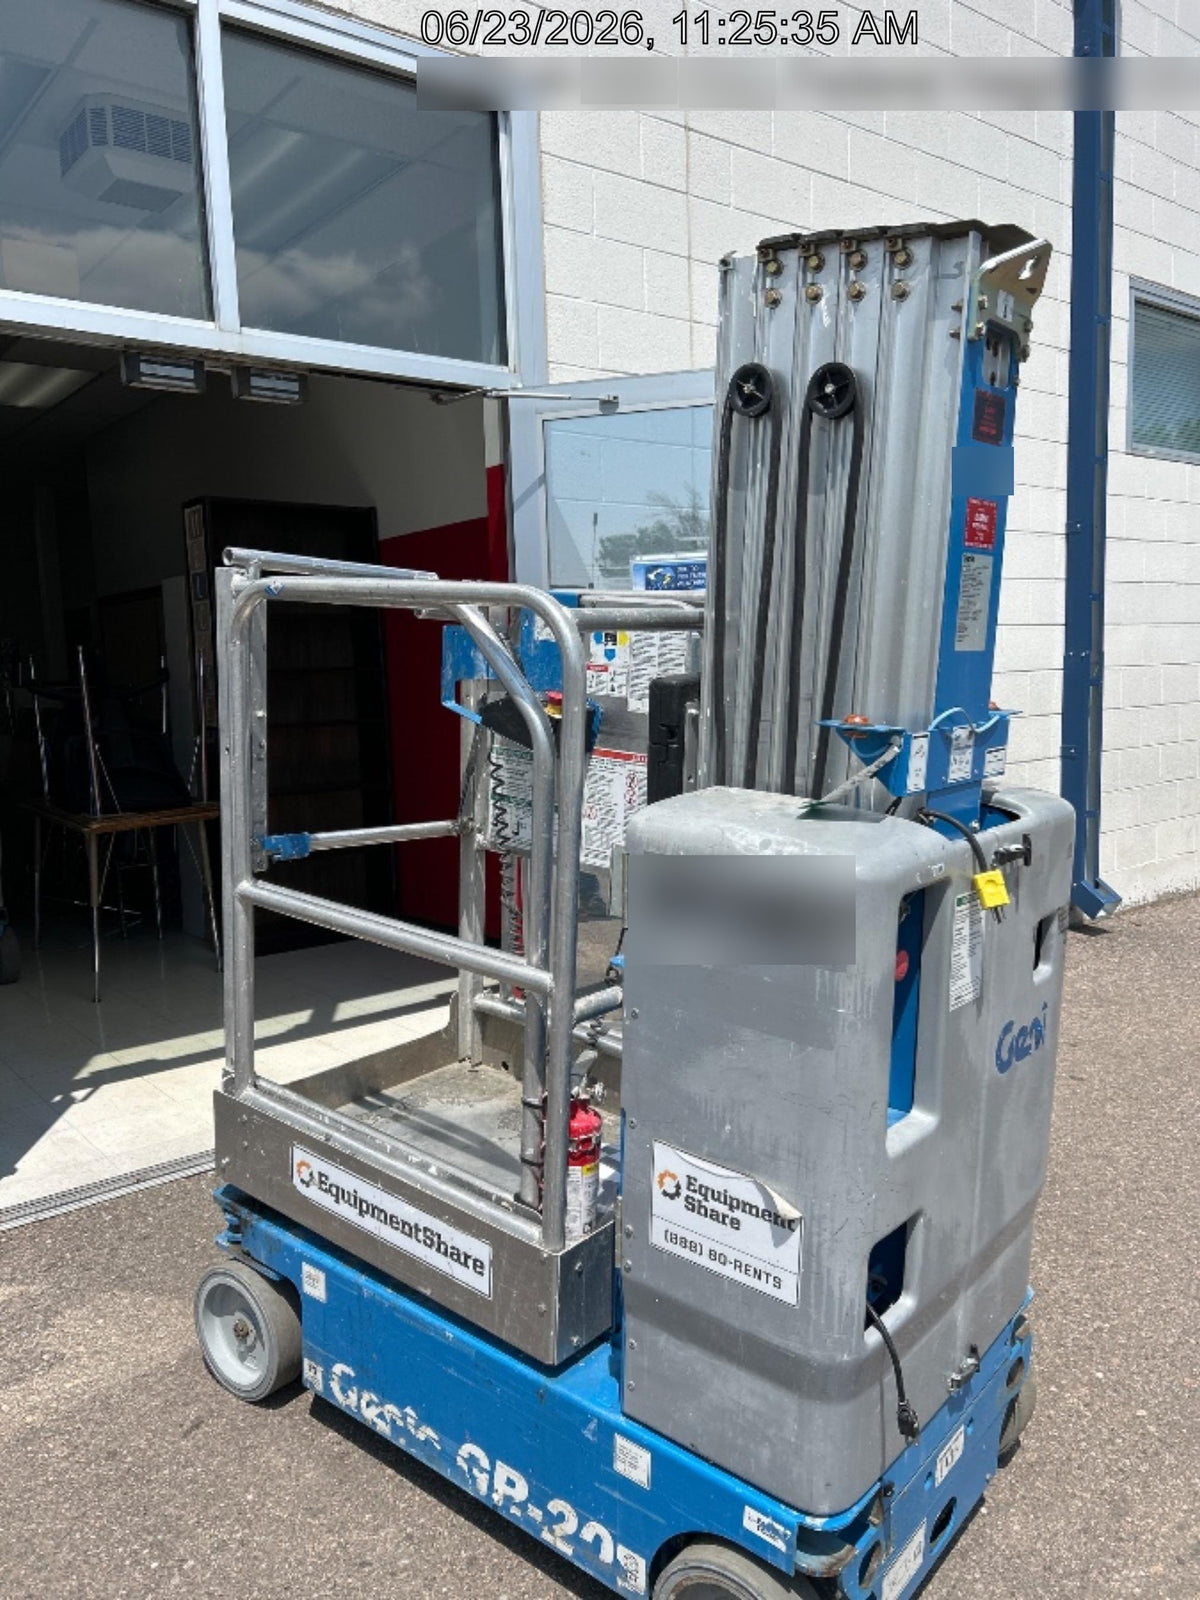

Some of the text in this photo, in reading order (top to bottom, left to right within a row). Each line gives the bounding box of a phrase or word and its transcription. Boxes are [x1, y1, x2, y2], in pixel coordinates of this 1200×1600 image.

[317, 1171, 486, 1277] EquipmentShare
[684, 1194, 741, 1231] Share
[685, 1174, 796, 1233] Equipment
[664, 1229, 704, 1256] (888)
